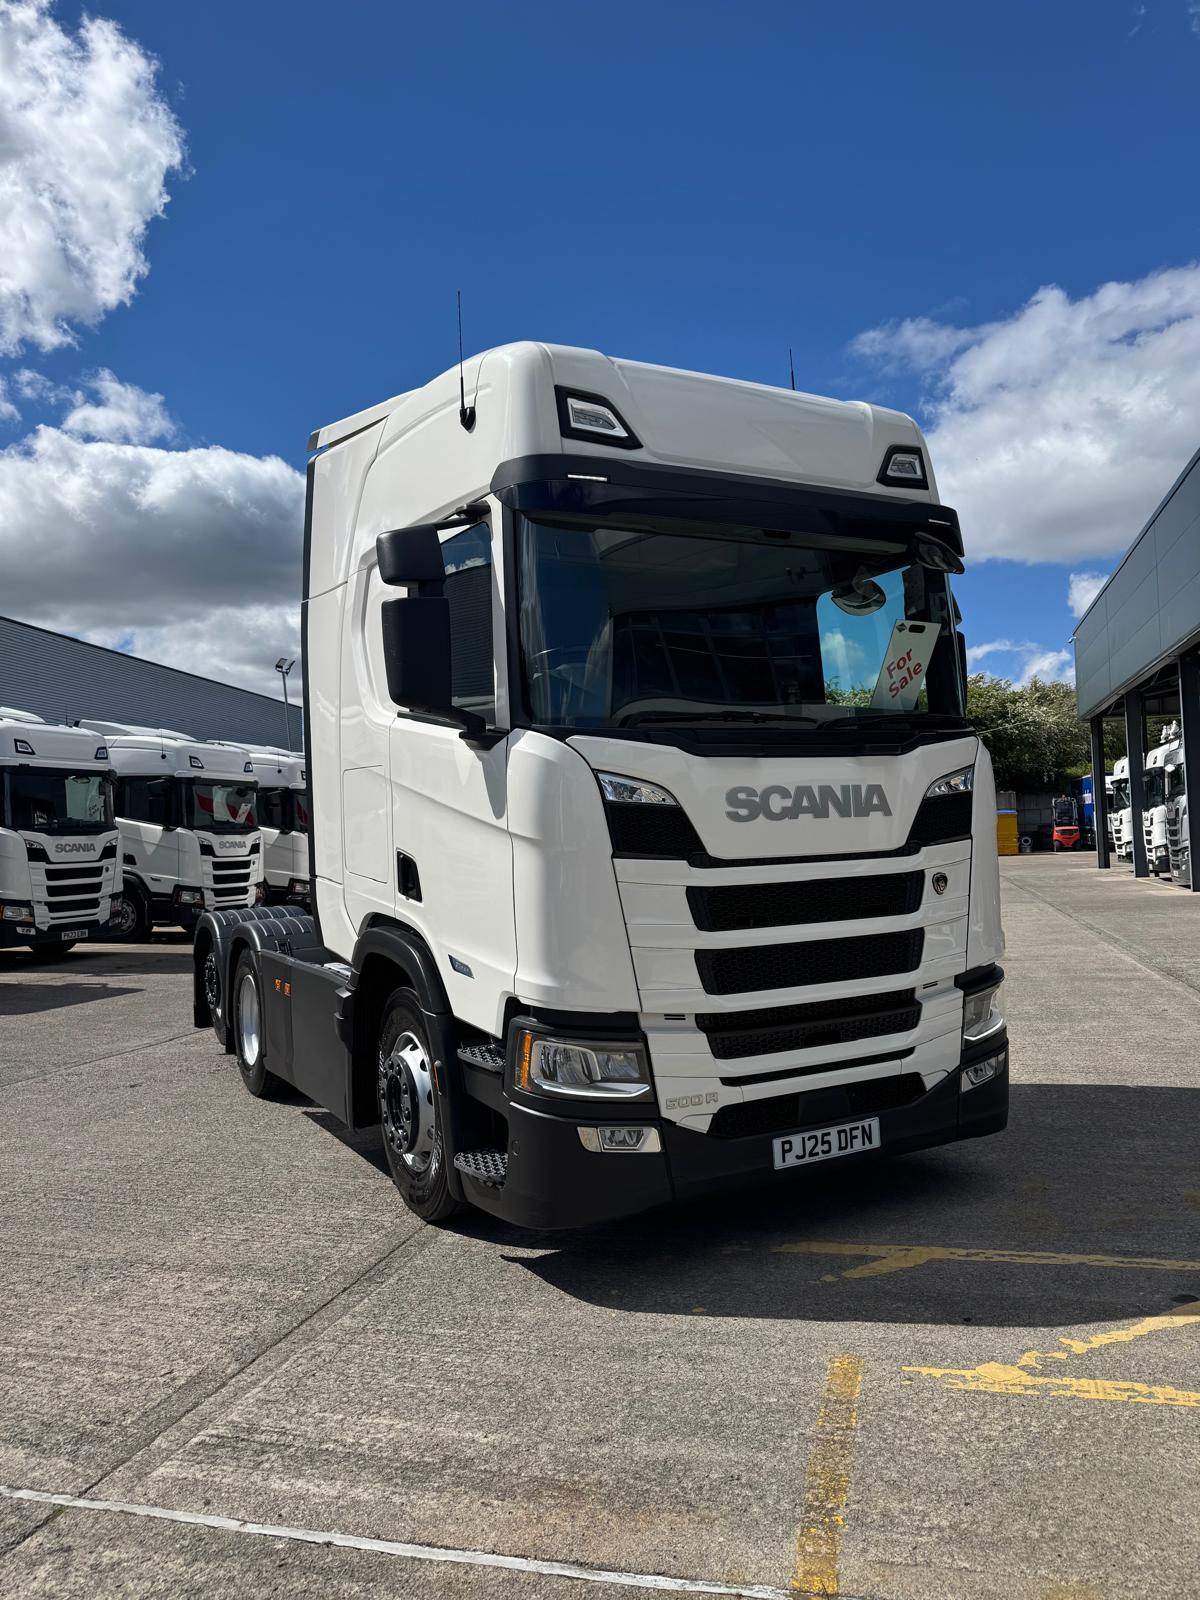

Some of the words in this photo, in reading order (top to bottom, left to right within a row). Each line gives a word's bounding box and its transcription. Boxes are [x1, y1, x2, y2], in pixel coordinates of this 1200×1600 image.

[886, 648, 912, 680] For
[888, 662, 923, 699] Sale
[725, 783, 893, 823] SCANIA
[54, 842, 97, 853] SCANIA
[218, 840, 247, 849] SCANIA
[665, 1094, 704, 1110] 500
[705, 1091, 719, 1104] R
[781, 1132, 832, 1163] PJ25
[837, 1123, 873, 1152] DFN
